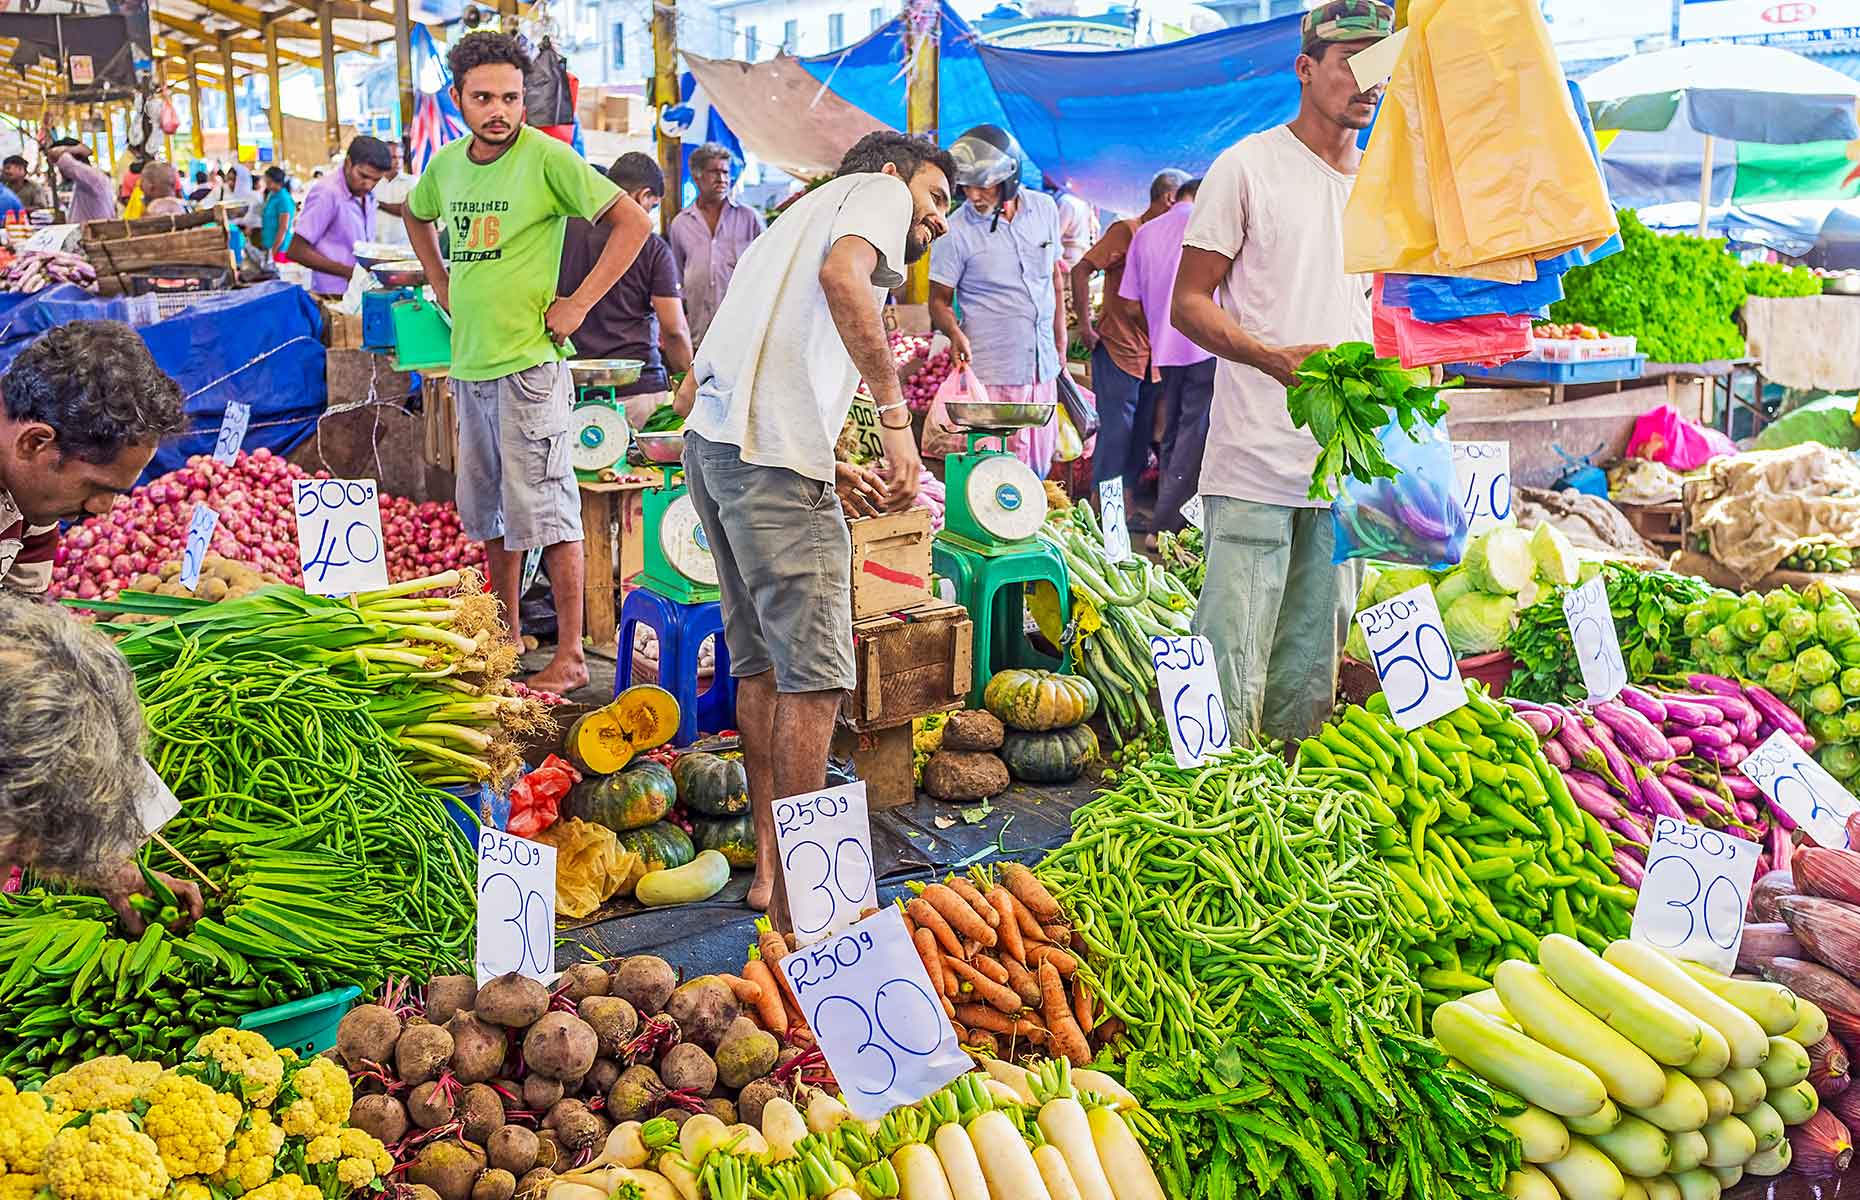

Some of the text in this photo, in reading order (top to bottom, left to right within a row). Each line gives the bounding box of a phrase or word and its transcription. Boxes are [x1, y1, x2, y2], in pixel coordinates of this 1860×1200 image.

[220, 427, 240, 456] 30
[858, 428, 885, 458] 30
[1464, 472, 1512, 528] 40
[303, 519, 379, 582] 40
[1151, 636, 1205, 671] 250
[1373, 624, 1453, 714] 50
[1174, 684, 1228, 759] 60
[786, 838, 873, 934] 30
[1644, 855, 1743, 950] 30
[482, 873, 551, 977] 30
[814, 978, 942, 1096] 30
